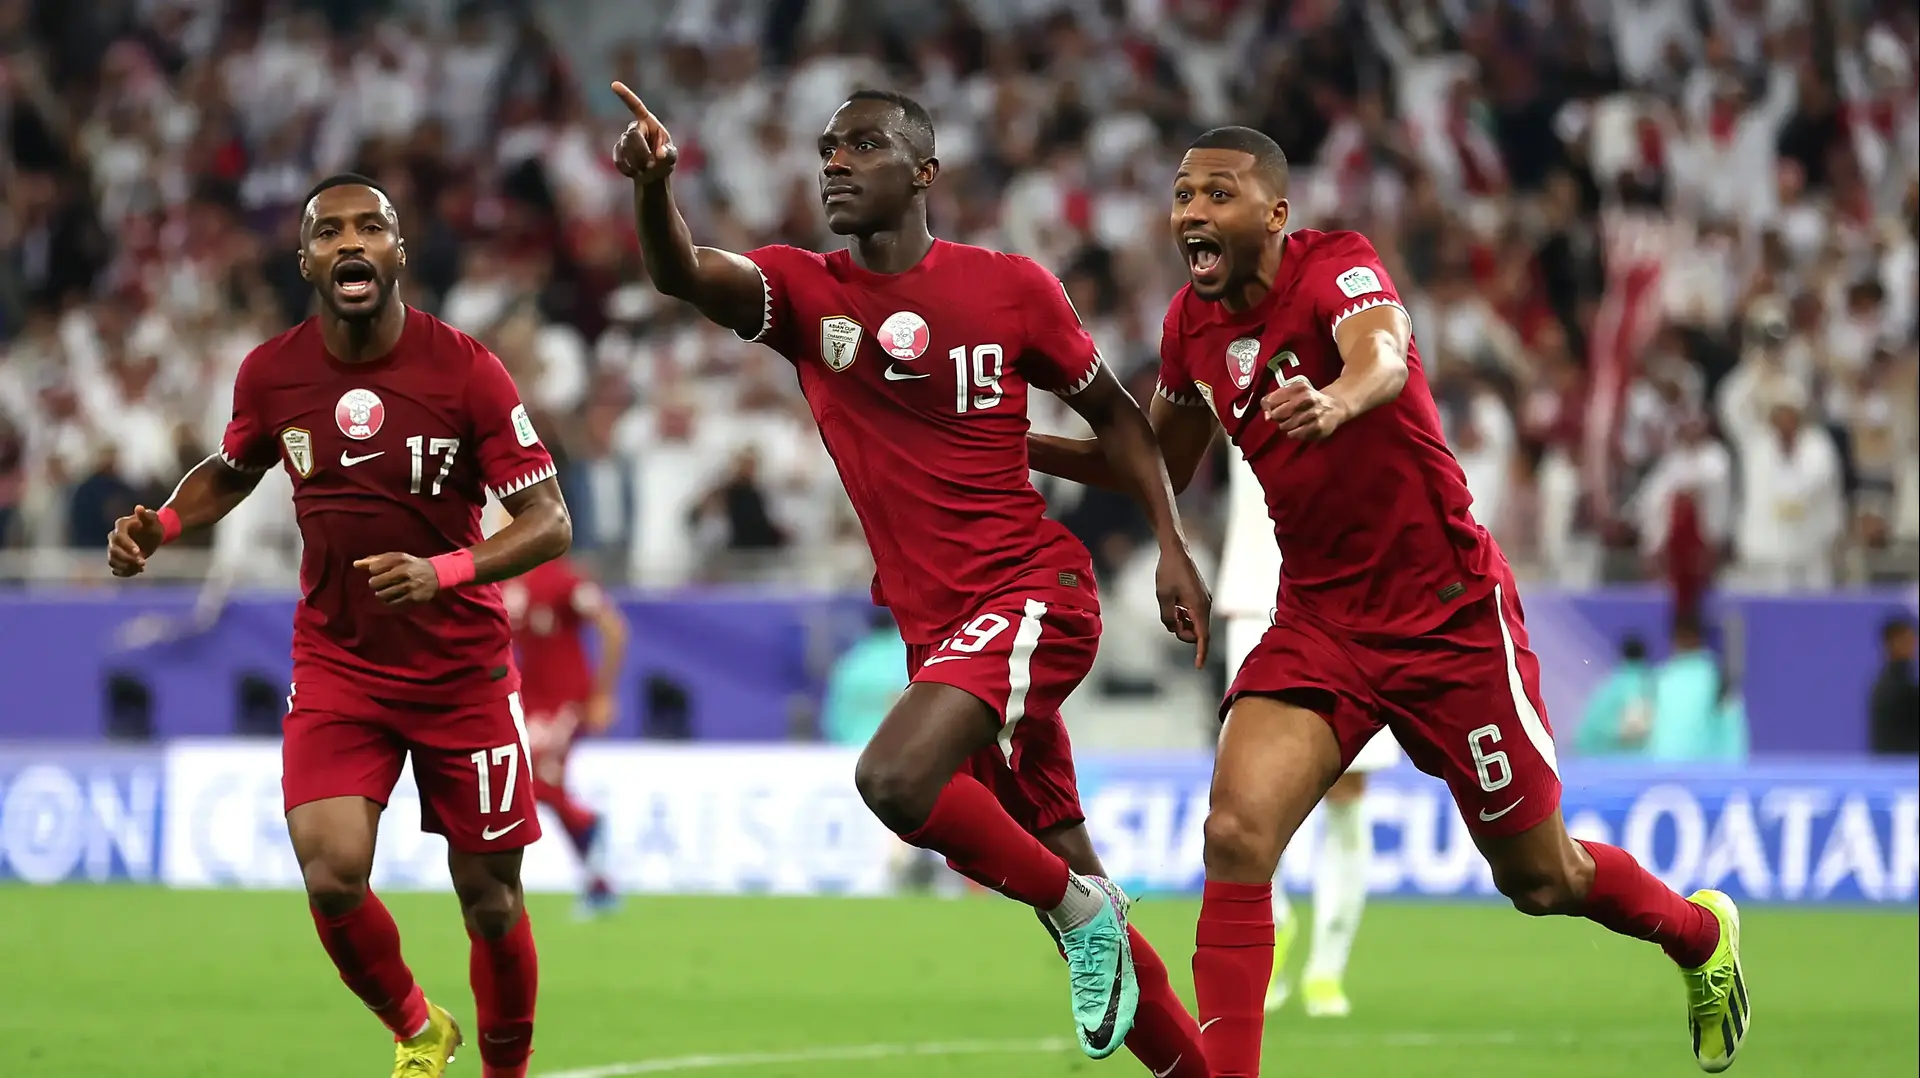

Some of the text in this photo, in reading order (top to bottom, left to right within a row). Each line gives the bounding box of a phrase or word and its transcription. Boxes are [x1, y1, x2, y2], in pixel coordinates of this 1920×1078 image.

[1343, 271, 1360, 282] AFC
[949, 343, 1003, 414] 19
[405, 435, 460, 496] 17
[471, 743, 518, 814] 17
[1467, 724, 1513, 792] 6
